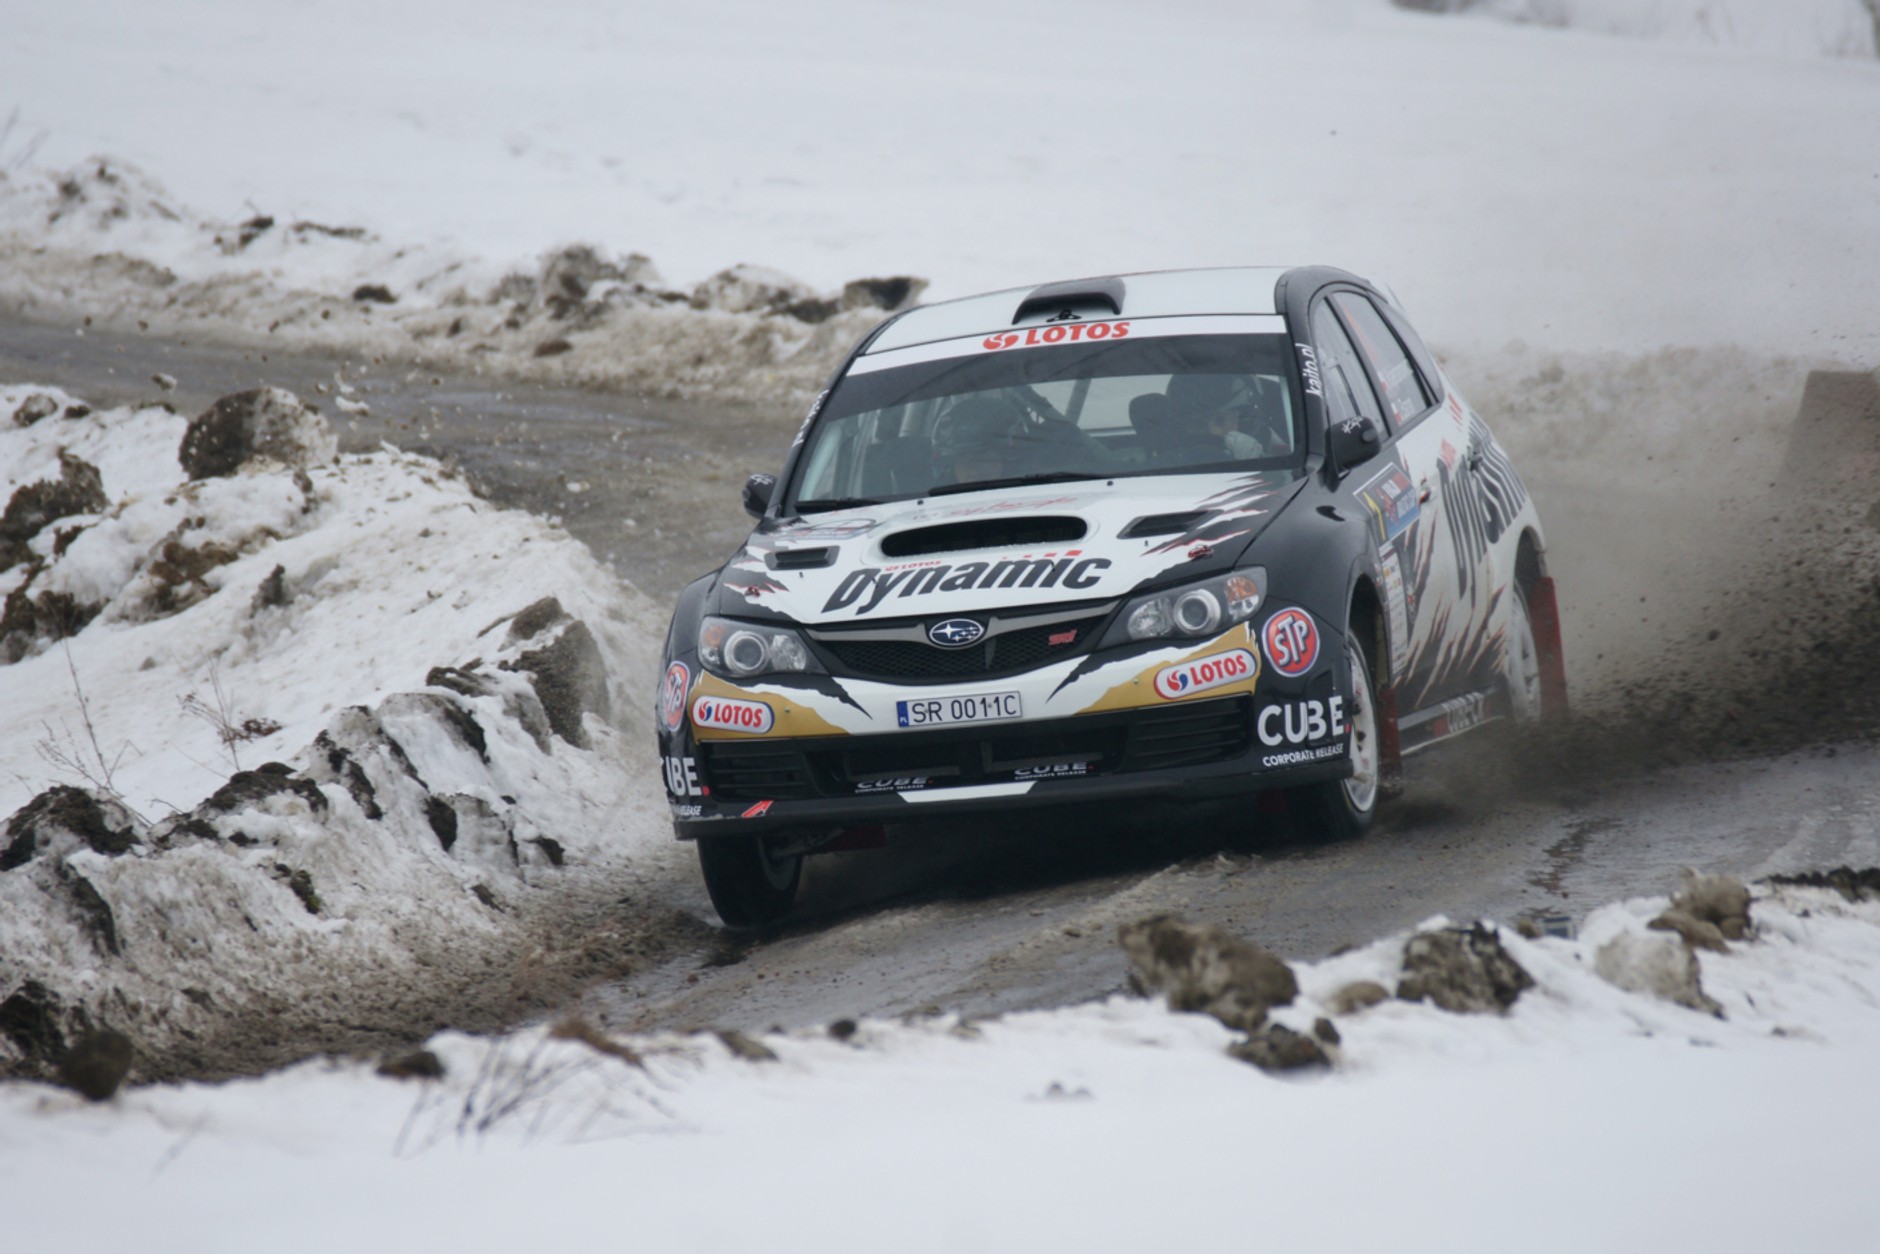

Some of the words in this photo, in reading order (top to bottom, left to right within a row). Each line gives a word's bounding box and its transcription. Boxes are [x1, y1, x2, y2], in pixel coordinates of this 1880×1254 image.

[1025, 322, 1130, 346] LOTOS
[821, 550, 1112, 616] Dynamic
[1274, 614, 1310, 666] STP
[1190, 654, 1247, 685] LOTOS
[714, 703, 763, 727] LOTOS
[912, 702, 943, 723] SR
[951, 695, 1017, 719] 0011C
[1263, 750, 1314, 767] CORPORATE
[1315, 743, 1344, 758] RELEASE
